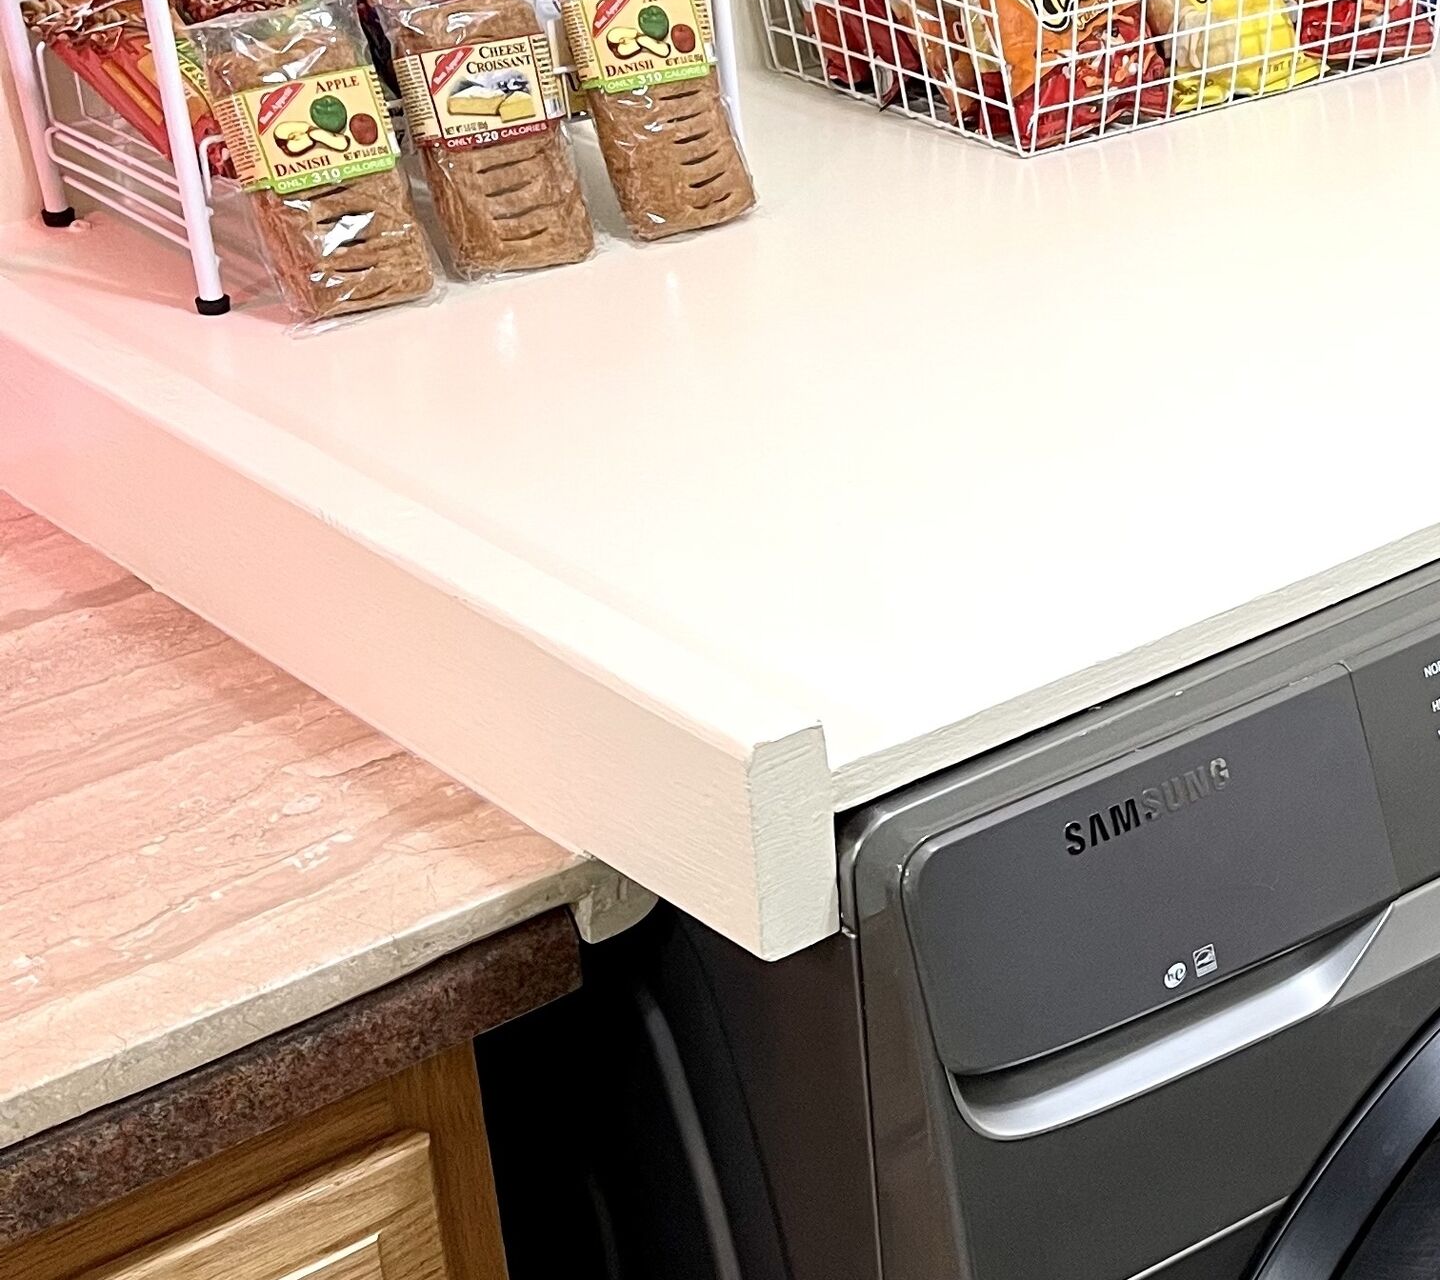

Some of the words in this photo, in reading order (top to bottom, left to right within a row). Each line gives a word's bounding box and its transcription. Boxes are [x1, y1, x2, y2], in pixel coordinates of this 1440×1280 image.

[479, 42, 526, 58] CHEESE
[466, 55, 531, 74] CROISSANT
[605, 60, 654, 77] DANISH
[315, 75, 360, 93] APPLE
[608, 79, 634, 90] ONLY
[637, 71, 662, 84] 310
[447, 137, 473, 148] ONLY
[476, 131, 499, 144] 320
[501, 122, 548, 138] CALORIES
[274, 155, 331, 177] DANISH
[277, 176, 308, 191] ONLY
[311, 168, 341, 183] 310
[343, 158, 394, 174] CALORIES
[1064, 757, 1230, 855] SAMSUNG
